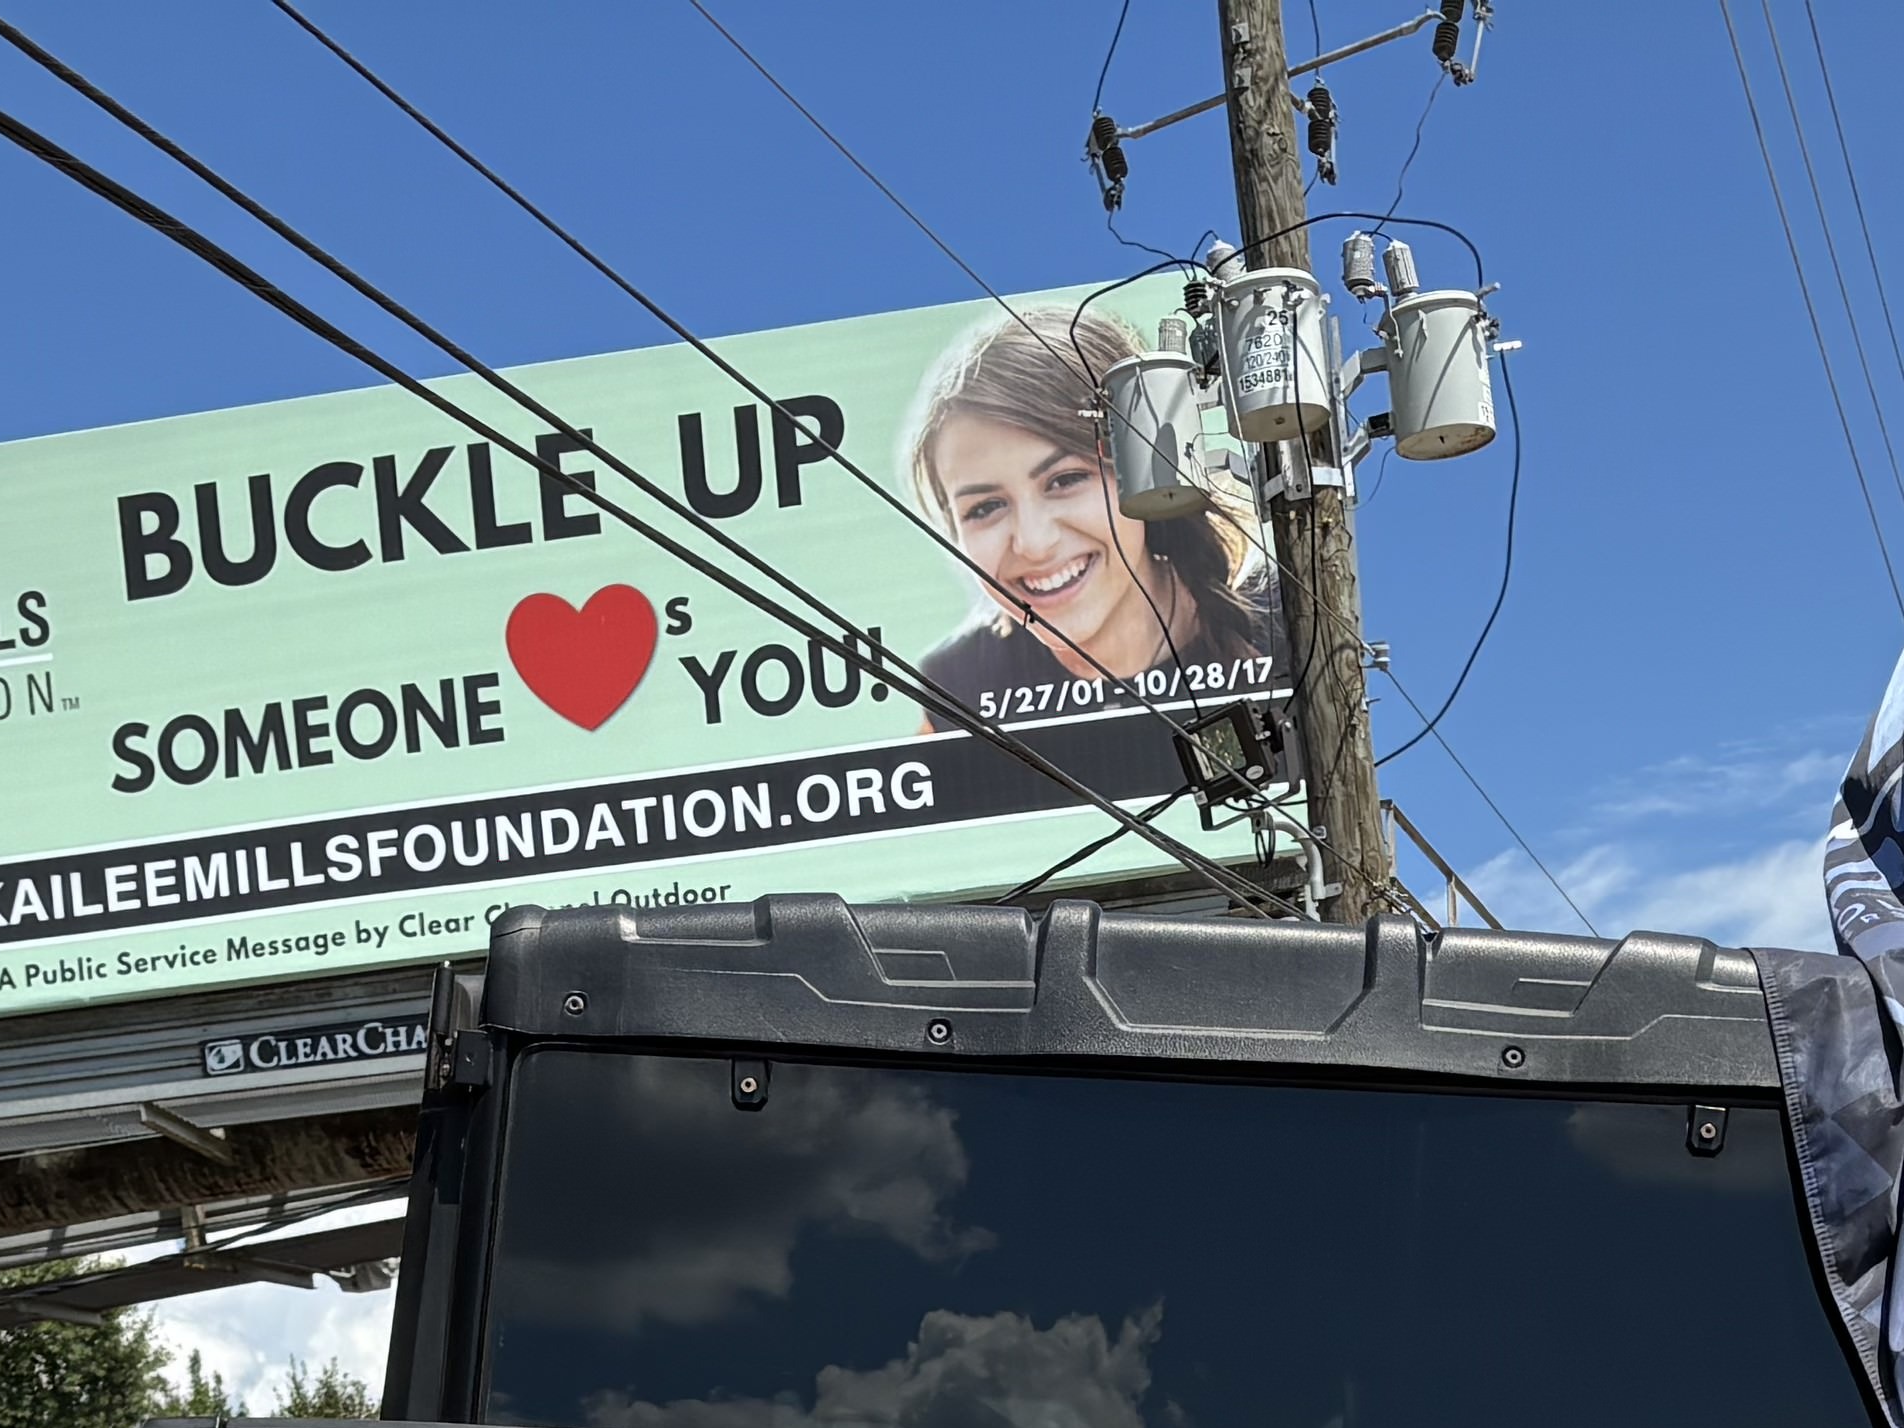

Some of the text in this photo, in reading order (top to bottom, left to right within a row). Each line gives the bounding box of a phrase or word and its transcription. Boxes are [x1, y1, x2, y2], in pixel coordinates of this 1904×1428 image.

[1245, 333, 1283, 352] 7620
[1266, 309, 1289, 326] 25
[117, 395, 846, 601] BUCKLE UP
[110, 671, 505, 794] SOMEONE
[678, 626, 889, 725] YOU!
[978, 677, 1104, 719] 5/27/01
[1134, 656, 1274, 698] 10/28/17
[24, 956, 108, 988] Public
[116, 945, 218, 977] Service
[226, 929, 346, 962] Message
[354, 920, 390, 949] by
[398, 911, 476, 939] Clear
[248, 1022, 428, 1069] CLEARCHA
